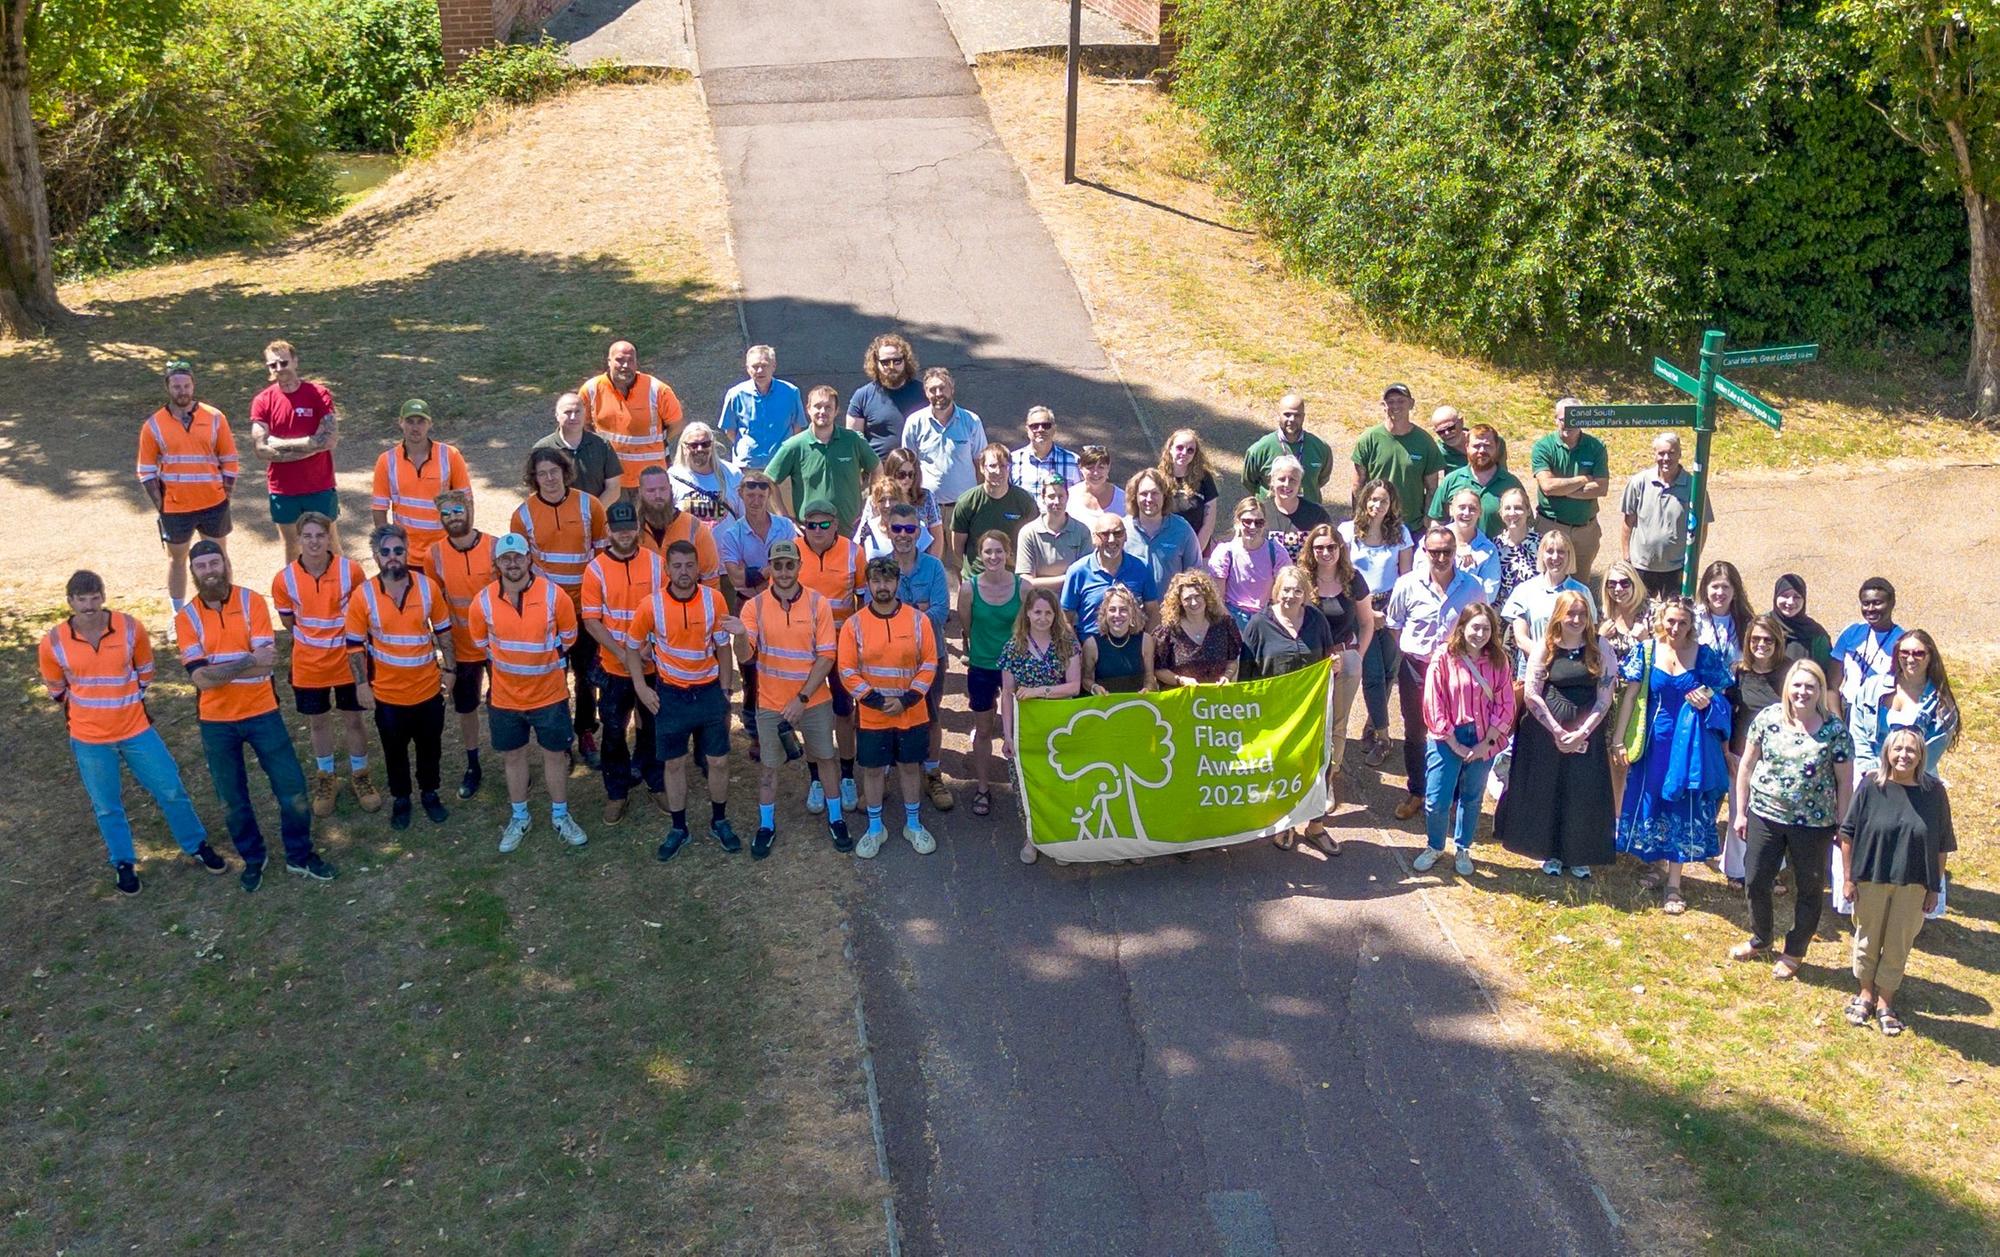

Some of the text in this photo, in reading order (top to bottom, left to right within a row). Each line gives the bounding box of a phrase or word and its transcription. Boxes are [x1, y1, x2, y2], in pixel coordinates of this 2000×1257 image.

[1722, 357, 1740, 366] Canal
[1759, 354, 1776, 363] Great
[1569, 408, 1616, 417] Canal South
[1569, 418, 1606, 427] Campbell
[1606, 418, 1623, 426] Park
[1631, 418, 1669, 426] Newlands
[690, 501, 725, 518] LOVE
[1192, 697, 1261, 720] Green
[1194, 725, 1243, 755] Flag
[1196, 747, 1274, 777] Award
[1198, 772, 1302, 806] 2025/26
